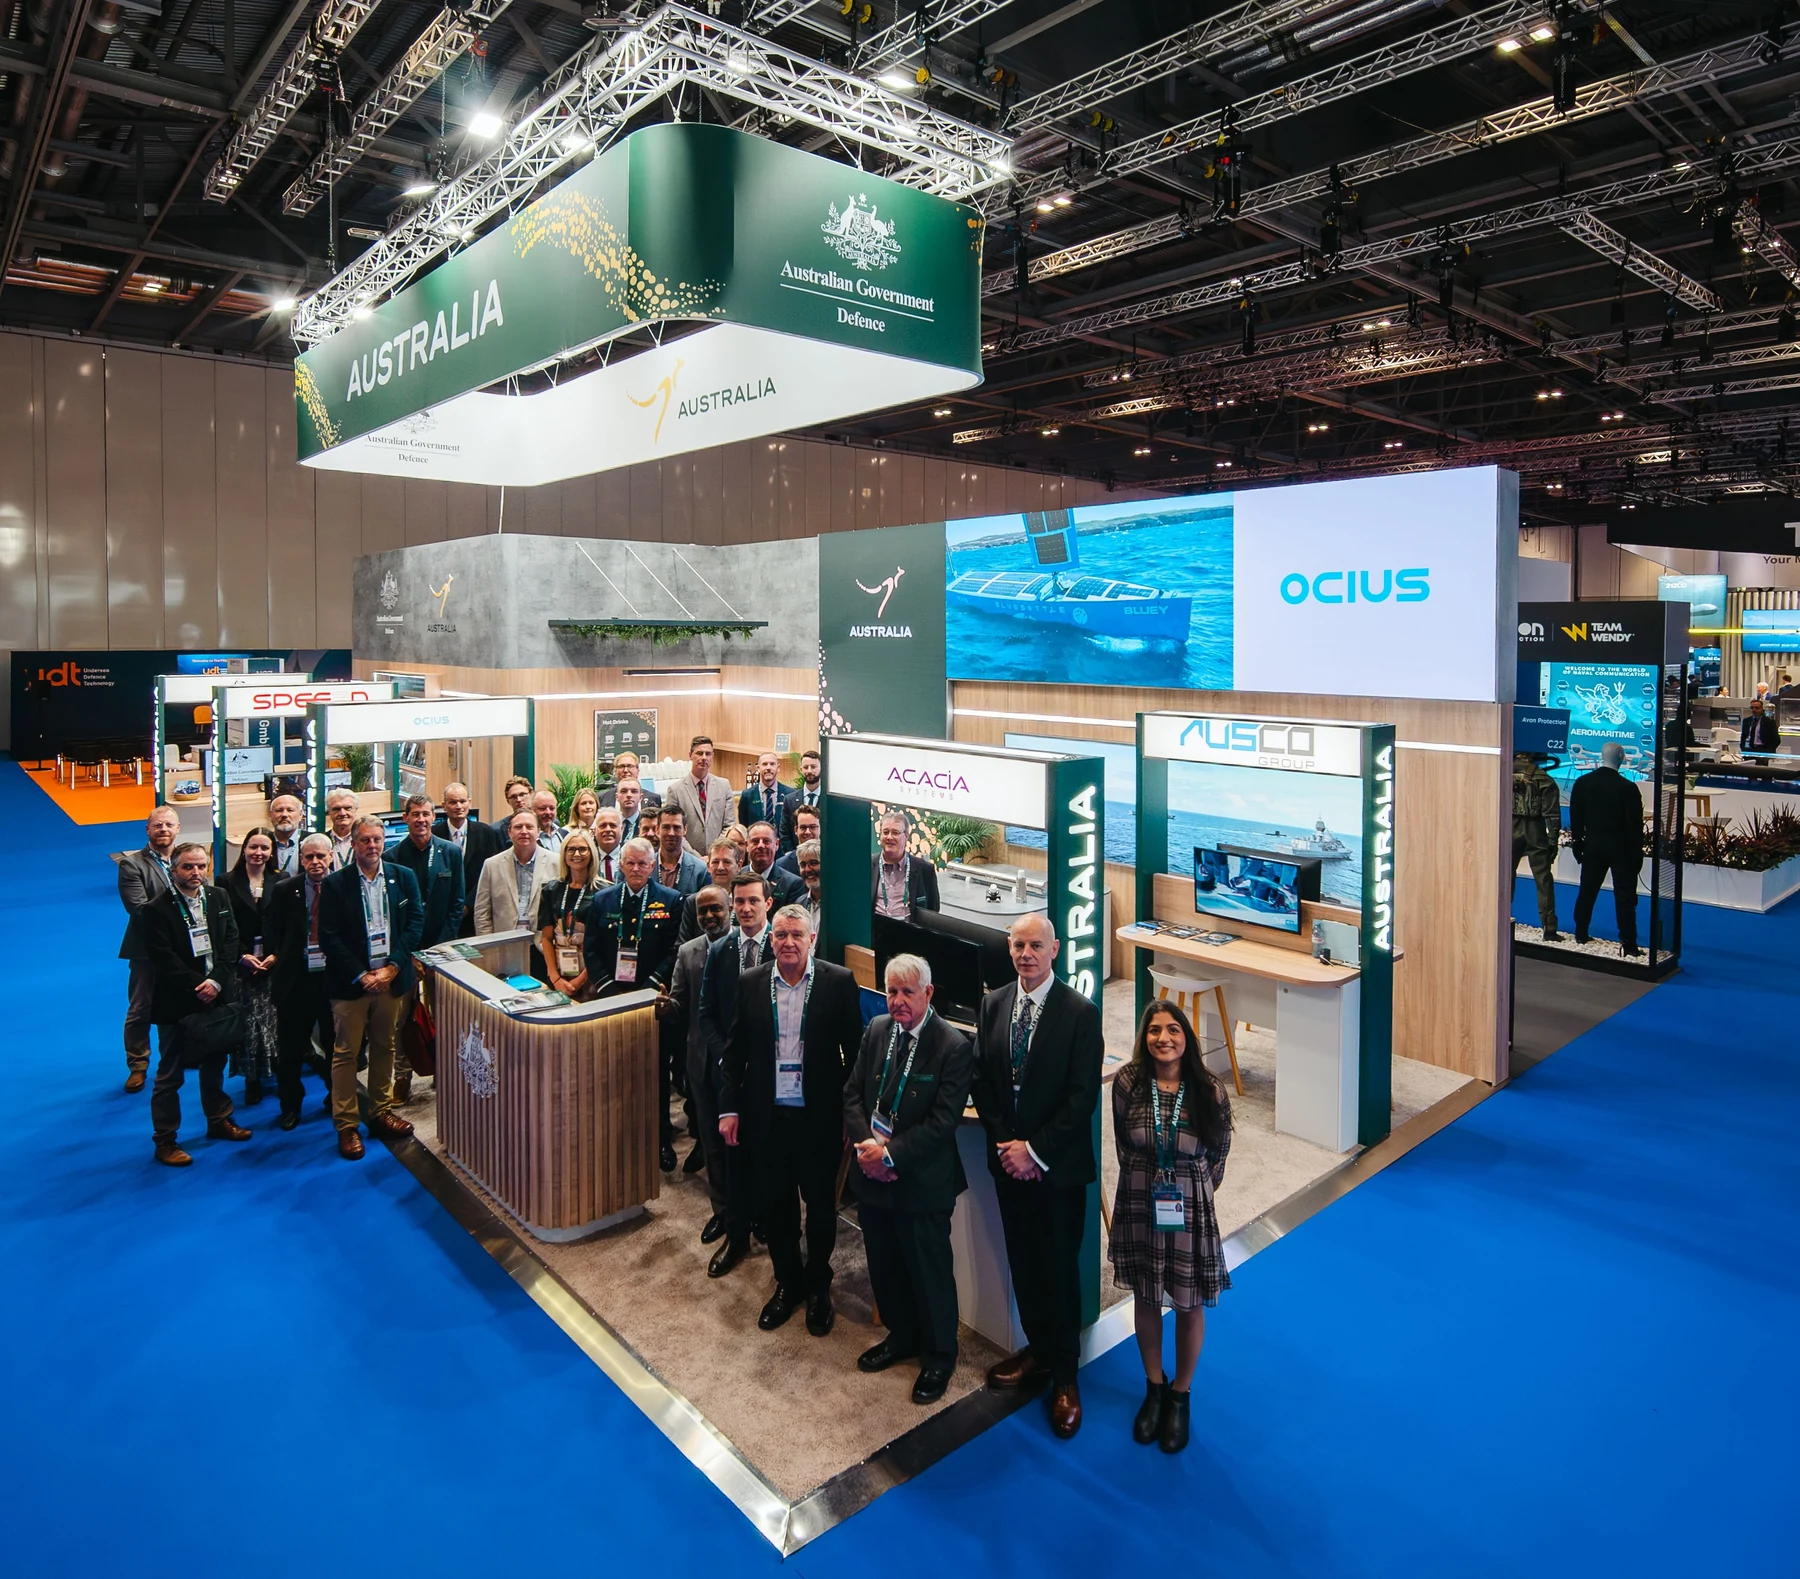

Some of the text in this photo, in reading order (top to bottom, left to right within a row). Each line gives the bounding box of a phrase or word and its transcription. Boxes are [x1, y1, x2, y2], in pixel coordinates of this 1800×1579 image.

[780, 260, 935, 313] Australian Government
[836, 307, 886, 332] Defence
[346, 279, 503, 402] AUSTRALIA
[678, 377, 777, 419] AUSTRALIA
[366, 434, 460, 452] Australian Government
[398, 453, 429, 464] Defence
[1764, 556, 1791, 564] Your
[1280, 568, 1430, 604] OCIUS
[1124, 606, 1169, 615] BLUEY
[427, 624, 458, 633] AUSTRALIA
[850, 625, 912, 638] AUSTRALIA
[1591, 622, 1622, 632] TEAM
[1591, 633, 1631, 642] WENDY
[414, 716, 450, 726] OCIUS
[1538, 718, 1566, 726] Protection
[258, 720, 270, 746] Gmb
[1570, 728, 1635, 738] AEROMARITIME
[1547, 740, 1564, 749] C22
[1258, 756, 1315, 770] GROUP
[900, 786, 954, 800] SYSTEMS
[1374, 745, 1392, 950] AUSTRALIA
[1068, 786, 1096, 1001] STRALIA
[805, 966, 815, 1004] AUSTRALIA
[1152, 1079, 1160, 1126] AUSTRALIA
